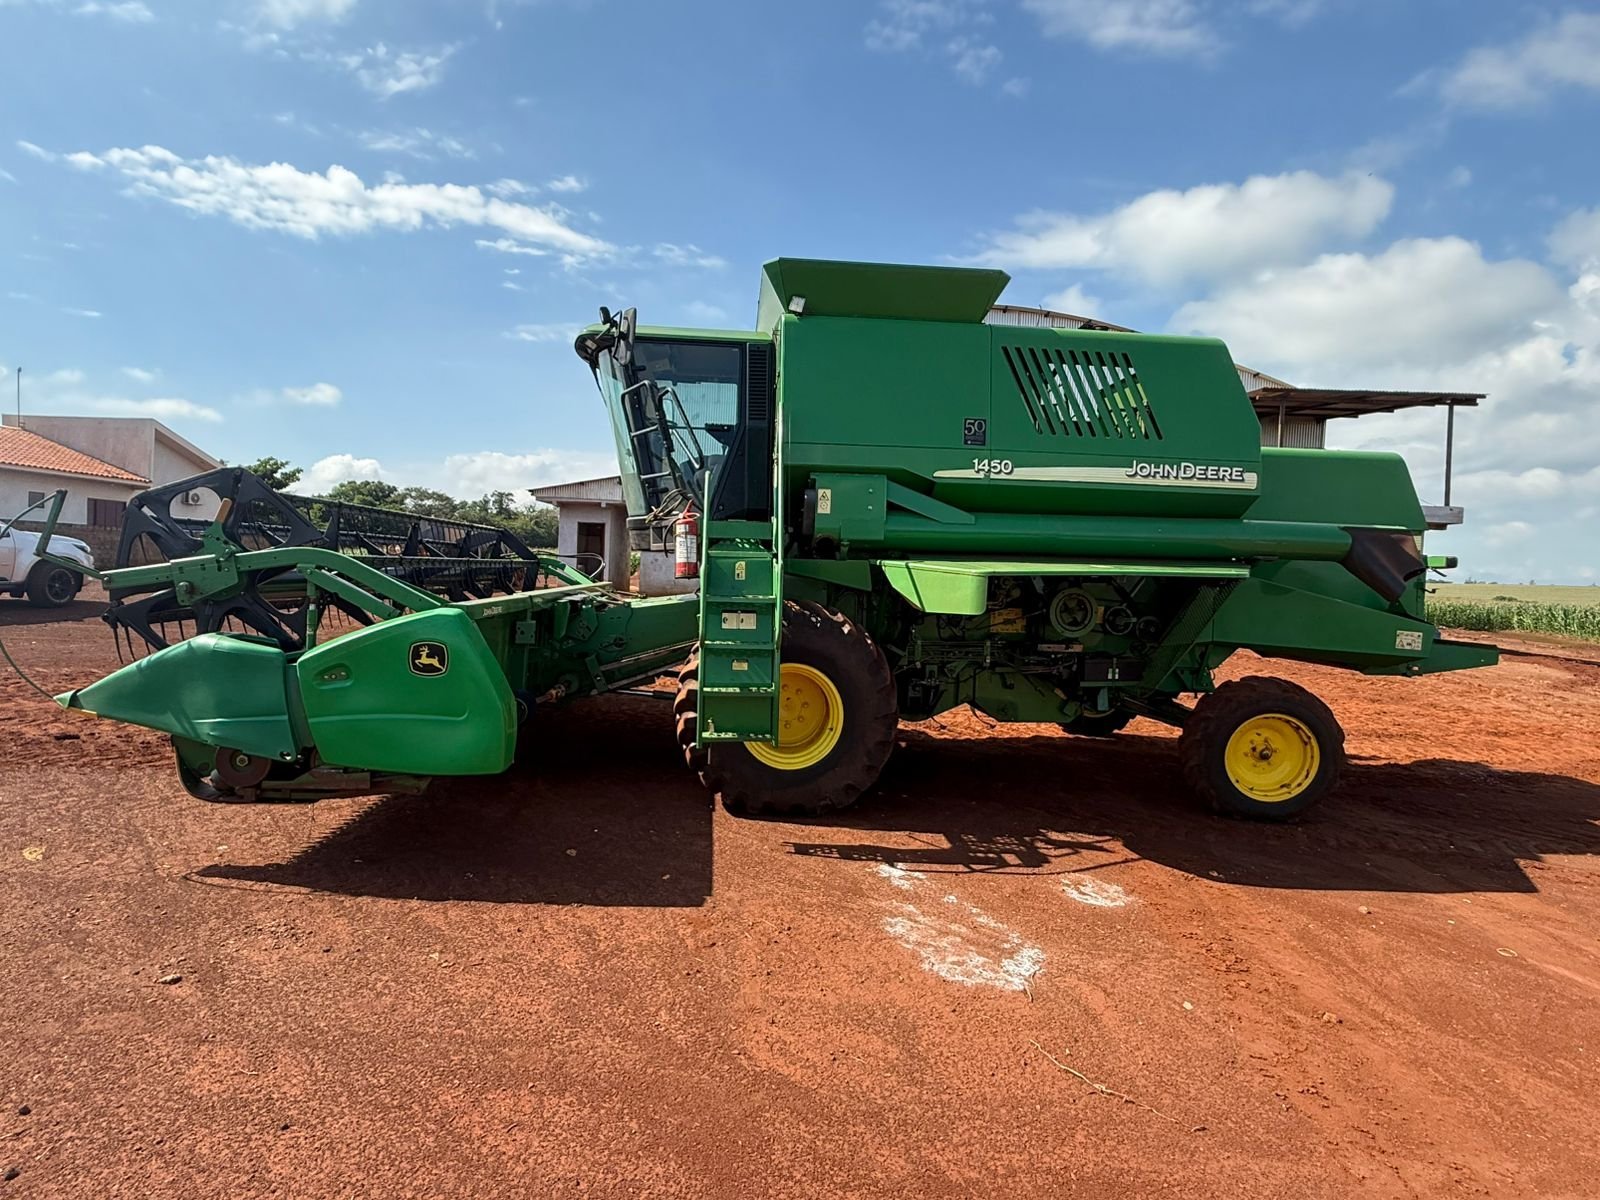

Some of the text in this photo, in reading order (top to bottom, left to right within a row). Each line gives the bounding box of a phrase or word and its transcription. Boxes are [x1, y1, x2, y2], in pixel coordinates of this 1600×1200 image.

[965, 419, 985, 435] 50
[972, 458, 1012, 473] 1450
[1126, 460, 1244, 480] JOHN DEERE
